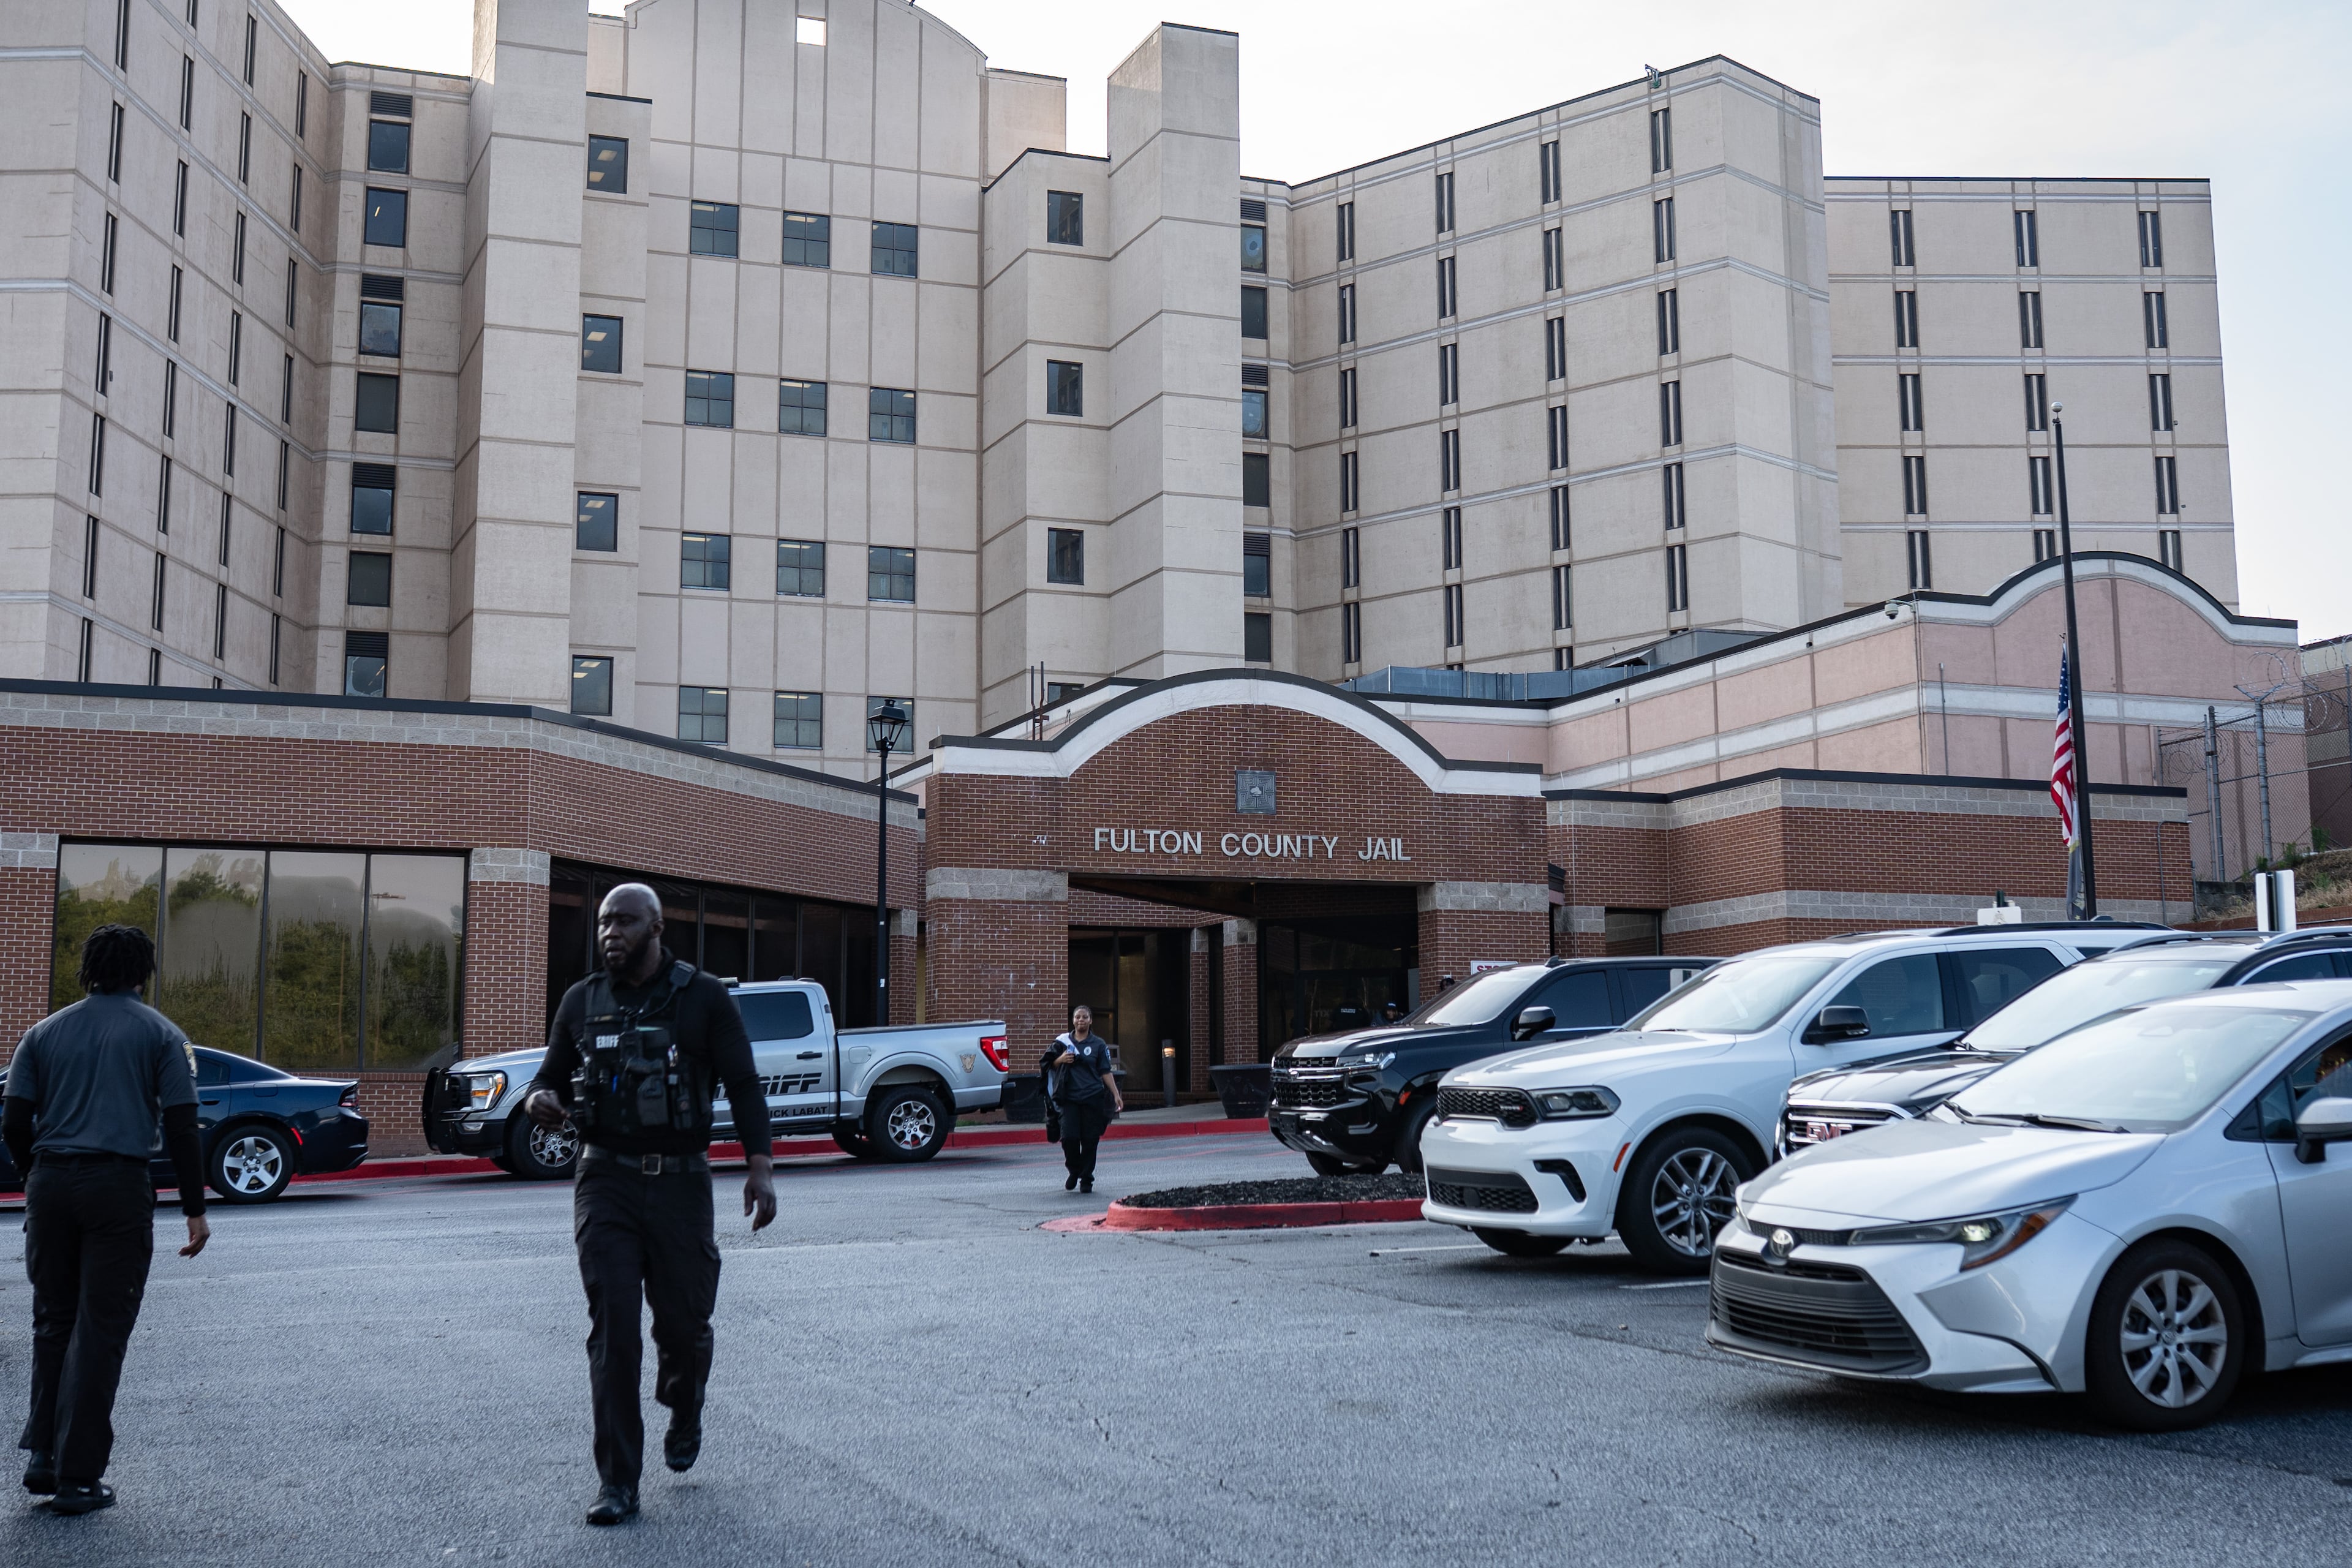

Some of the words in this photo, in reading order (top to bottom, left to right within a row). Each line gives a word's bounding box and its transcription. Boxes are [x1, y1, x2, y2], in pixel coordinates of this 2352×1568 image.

[1095, 828, 1202, 854] FULTON
[1221, 833, 1339, 859] COUNTY
[1358, 836, 1411, 861] JAIL
[770, 1109, 789, 1118] ICK
[793, 1106, 828, 1117] LABAT
